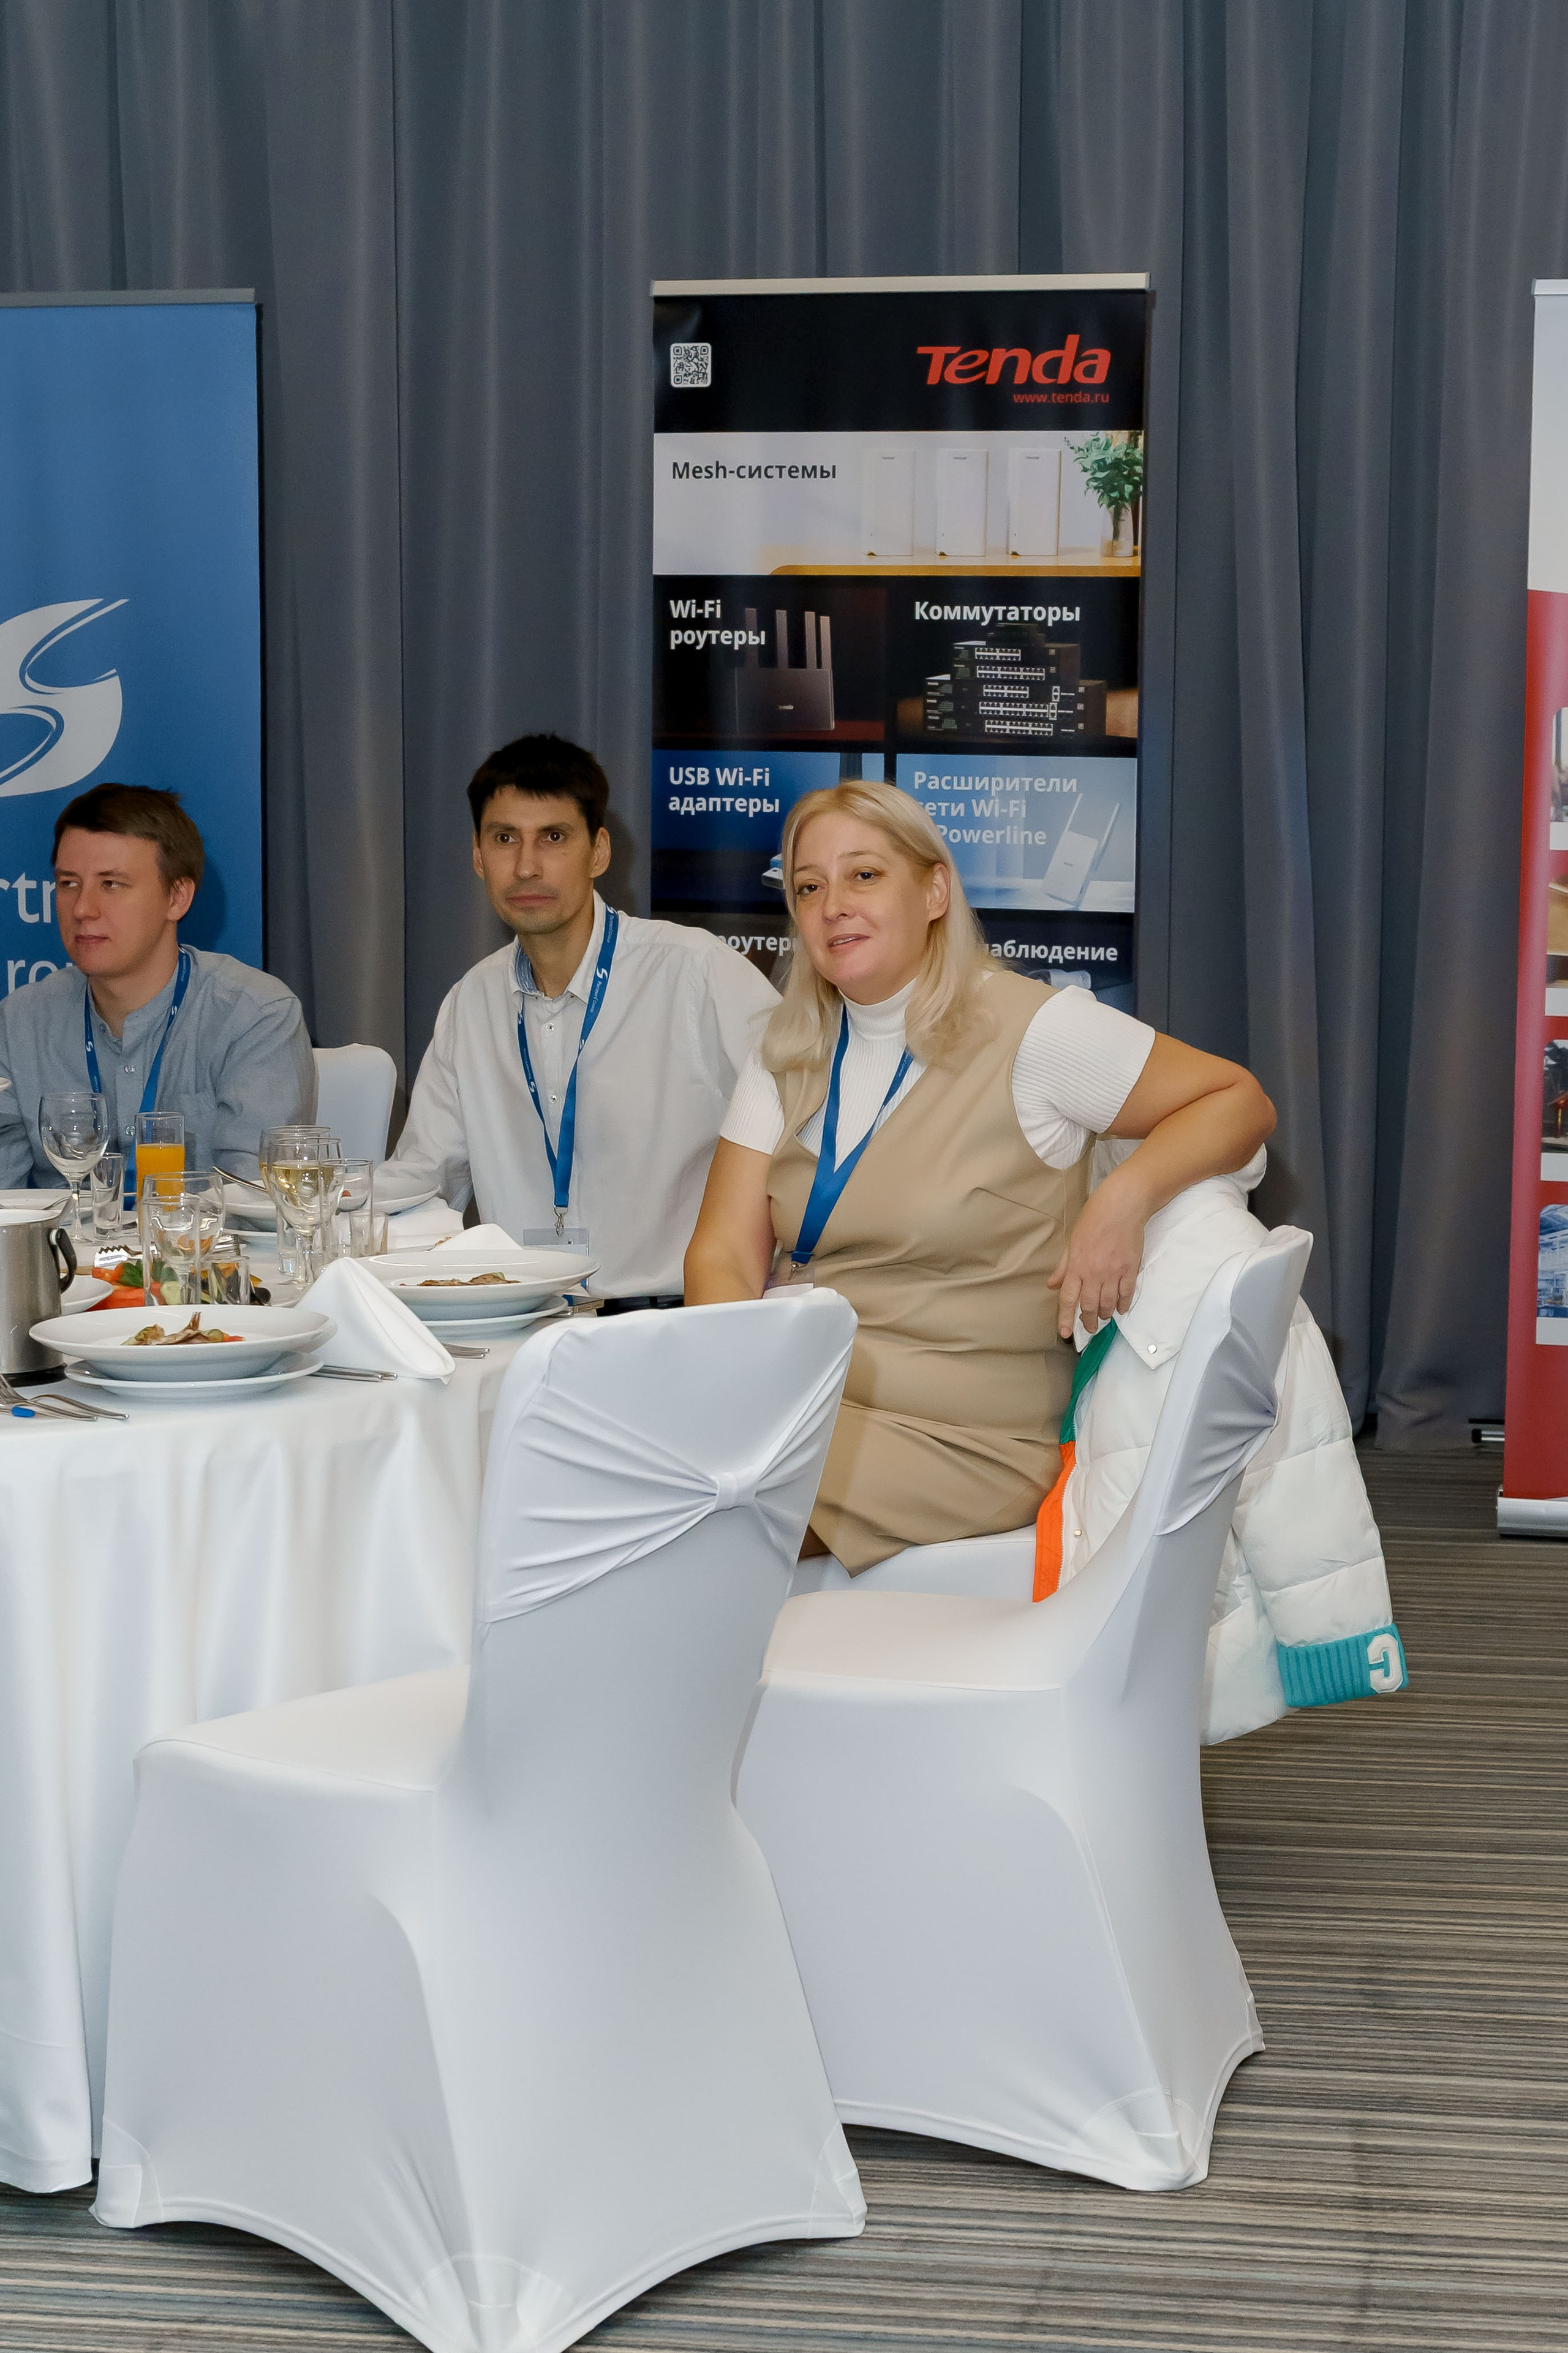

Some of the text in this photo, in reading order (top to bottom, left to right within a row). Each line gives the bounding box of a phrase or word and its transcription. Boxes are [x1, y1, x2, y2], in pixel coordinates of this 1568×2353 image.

[917, 334, 1111, 385] Tenda
[1013, 391, 1109, 403] www.tenda.ru
[672, 460, 837, 479] Mesh-системы
[670, 599, 721, 618] Wi-Fi
[914, 601, 1080, 627] Коммутаторы
[671, 630, 766, 650] роутеры
[669, 767, 769, 787] USB Wi-Fi
[914, 771, 1078, 796] Расширители
[669, 796, 780, 817] адаптеры
[971, 799, 1027, 818] Wi-Fi
[716, 935, 801, 957] оутер
